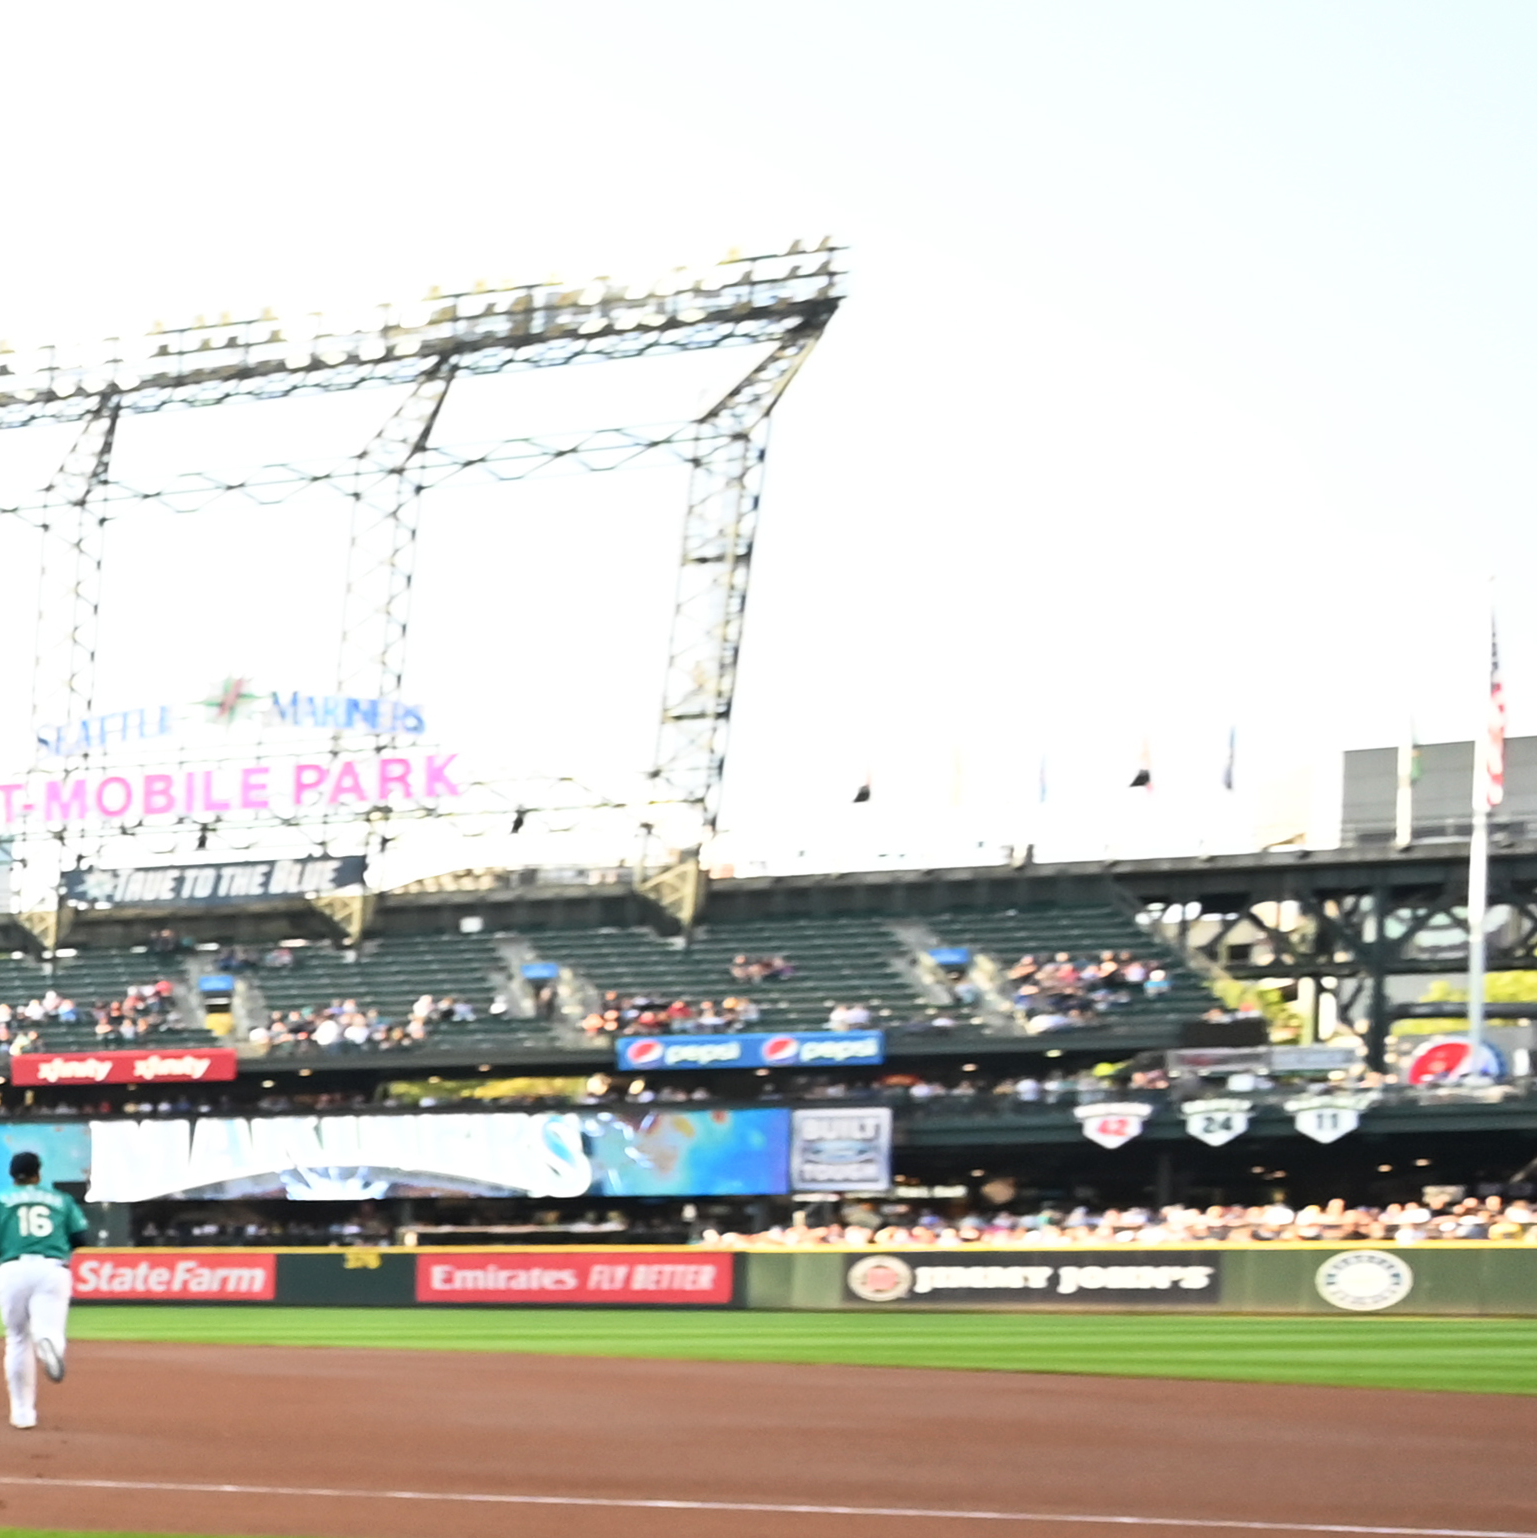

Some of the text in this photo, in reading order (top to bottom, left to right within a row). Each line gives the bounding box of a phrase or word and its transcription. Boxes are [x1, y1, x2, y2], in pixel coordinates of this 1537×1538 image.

[293, 753, 460, 806] PARK
[181, 868, 217, 898] TO
[664, 1041, 742, 1065] pepsi
[799, 1037, 880, 1062] pepsi
[1203, 1116, 1233, 1134] 24
[1316, 1112, 1339, 1130] 11
[17, 1205, 54, 1237] 16
[429, 1263, 579, 1292] Emirates
[629, 1263, 717, 1291] BETTER
[915, 1266, 1053, 1293] JIMMY
[1058, 1266, 1213, 1294] JOHN'S
